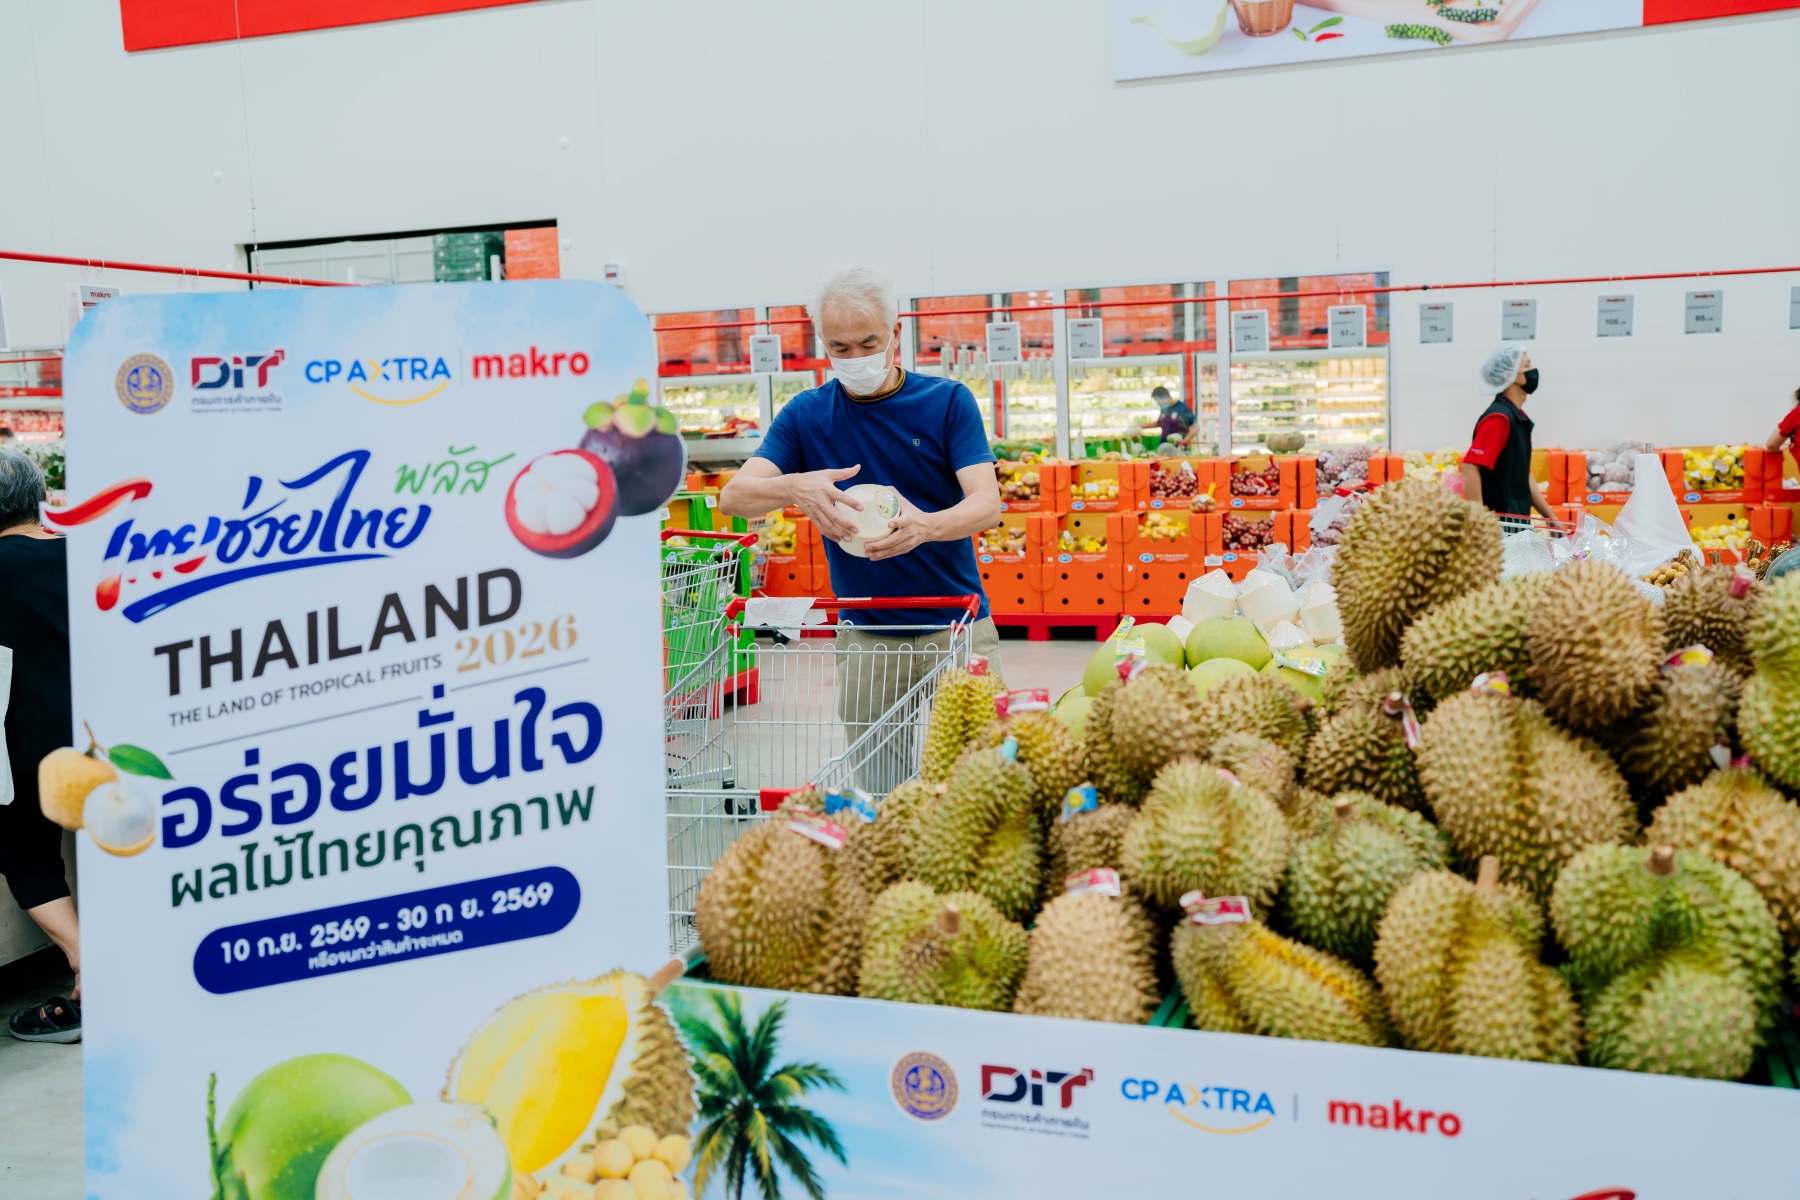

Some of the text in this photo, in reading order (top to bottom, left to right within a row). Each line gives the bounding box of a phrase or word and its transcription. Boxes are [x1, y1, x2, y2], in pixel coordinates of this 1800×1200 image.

[90, 291, 111, 299] makro
[304, 345, 590, 383] CP AXTRA makro
[394, 445, 516, 497] พลัส
[153, 567, 522, 696] THAILAND
[454, 613, 578, 674] 2026
[169, 654, 442, 727] THE LAND OF TROPICAL FRUITS
[161, 683, 603, 850] อร่อยมั่นใจ
[170, 785, 595, 908] ผลไม้ไทยคุณภาพ
[220, 938, 251, 964] 10
[257, 932, 302, 958] ก.ย.
[309, 915, 371, 949] 2569
[396, 904, 428, 932] 30
[491, 881, 554, 915] 2569
[1120, 1078, 1462, 1138] CP AXTRA makro
